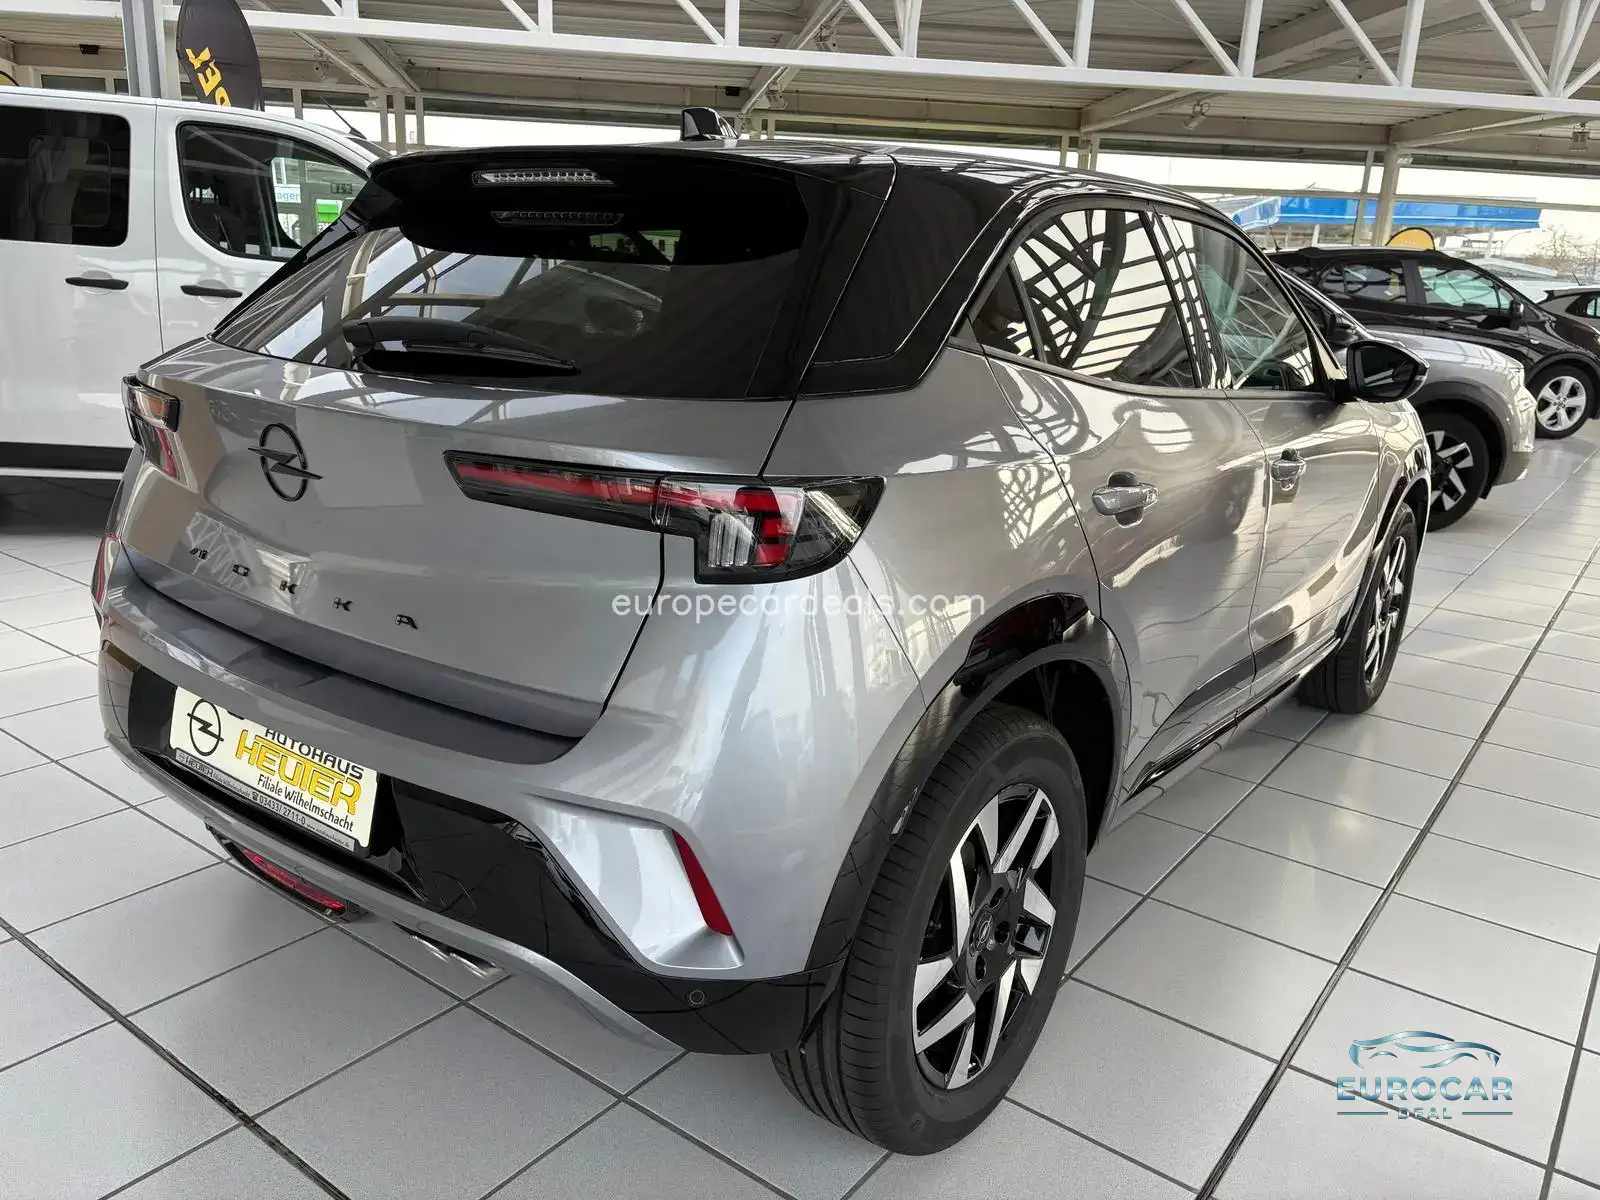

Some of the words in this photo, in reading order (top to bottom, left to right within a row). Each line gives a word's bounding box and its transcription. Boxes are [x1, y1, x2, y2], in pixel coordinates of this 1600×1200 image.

[190, 546, 418, 630] MOKKA
[235, 729, 362, 815] HEUTER
[265, 728, 364, 780] AUTOHAUS
[185, 755, 214, 778] HEUTER
[283, 806, 306, 826] 2711-0
[257, 773, 283, 797] Filiale
[285, 785, 354, 833] Wilhelmschacht
